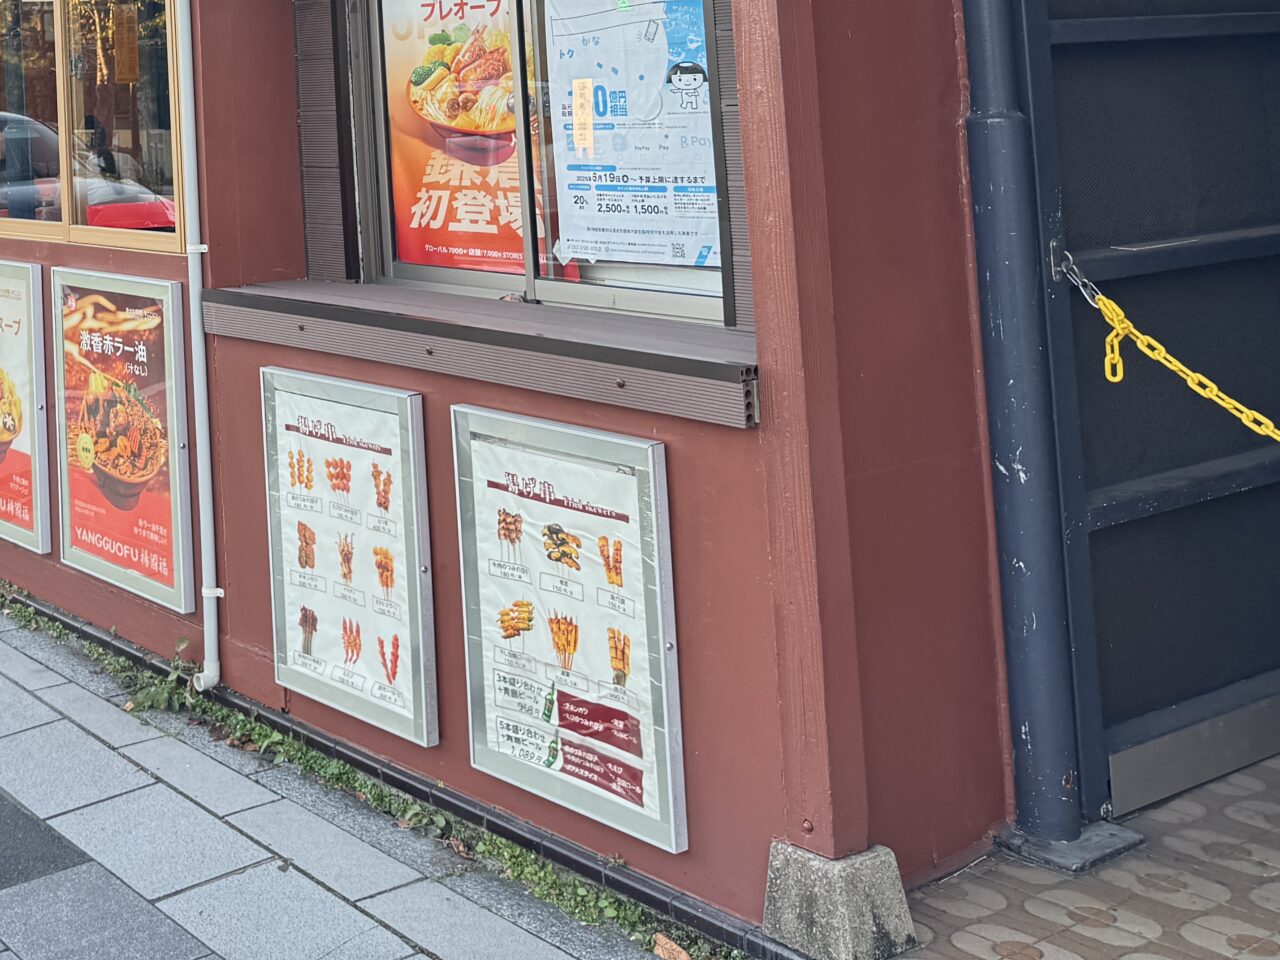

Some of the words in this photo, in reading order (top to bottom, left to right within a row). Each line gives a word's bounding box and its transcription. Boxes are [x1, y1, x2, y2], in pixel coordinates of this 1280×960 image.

[80, 329, 147, 363] 激香赤ラー油
[505, 471, 556, 503] 揚げ串
[563, 496, 583, 510] Fried
[584, 501, 616, 517] skewers
[75, 526, 138, 562] YANGGUOFU
[496, 673, 543, 697] 3本盛り合わせ
[499, 720, 547, 744] 5本盛り合わせ
